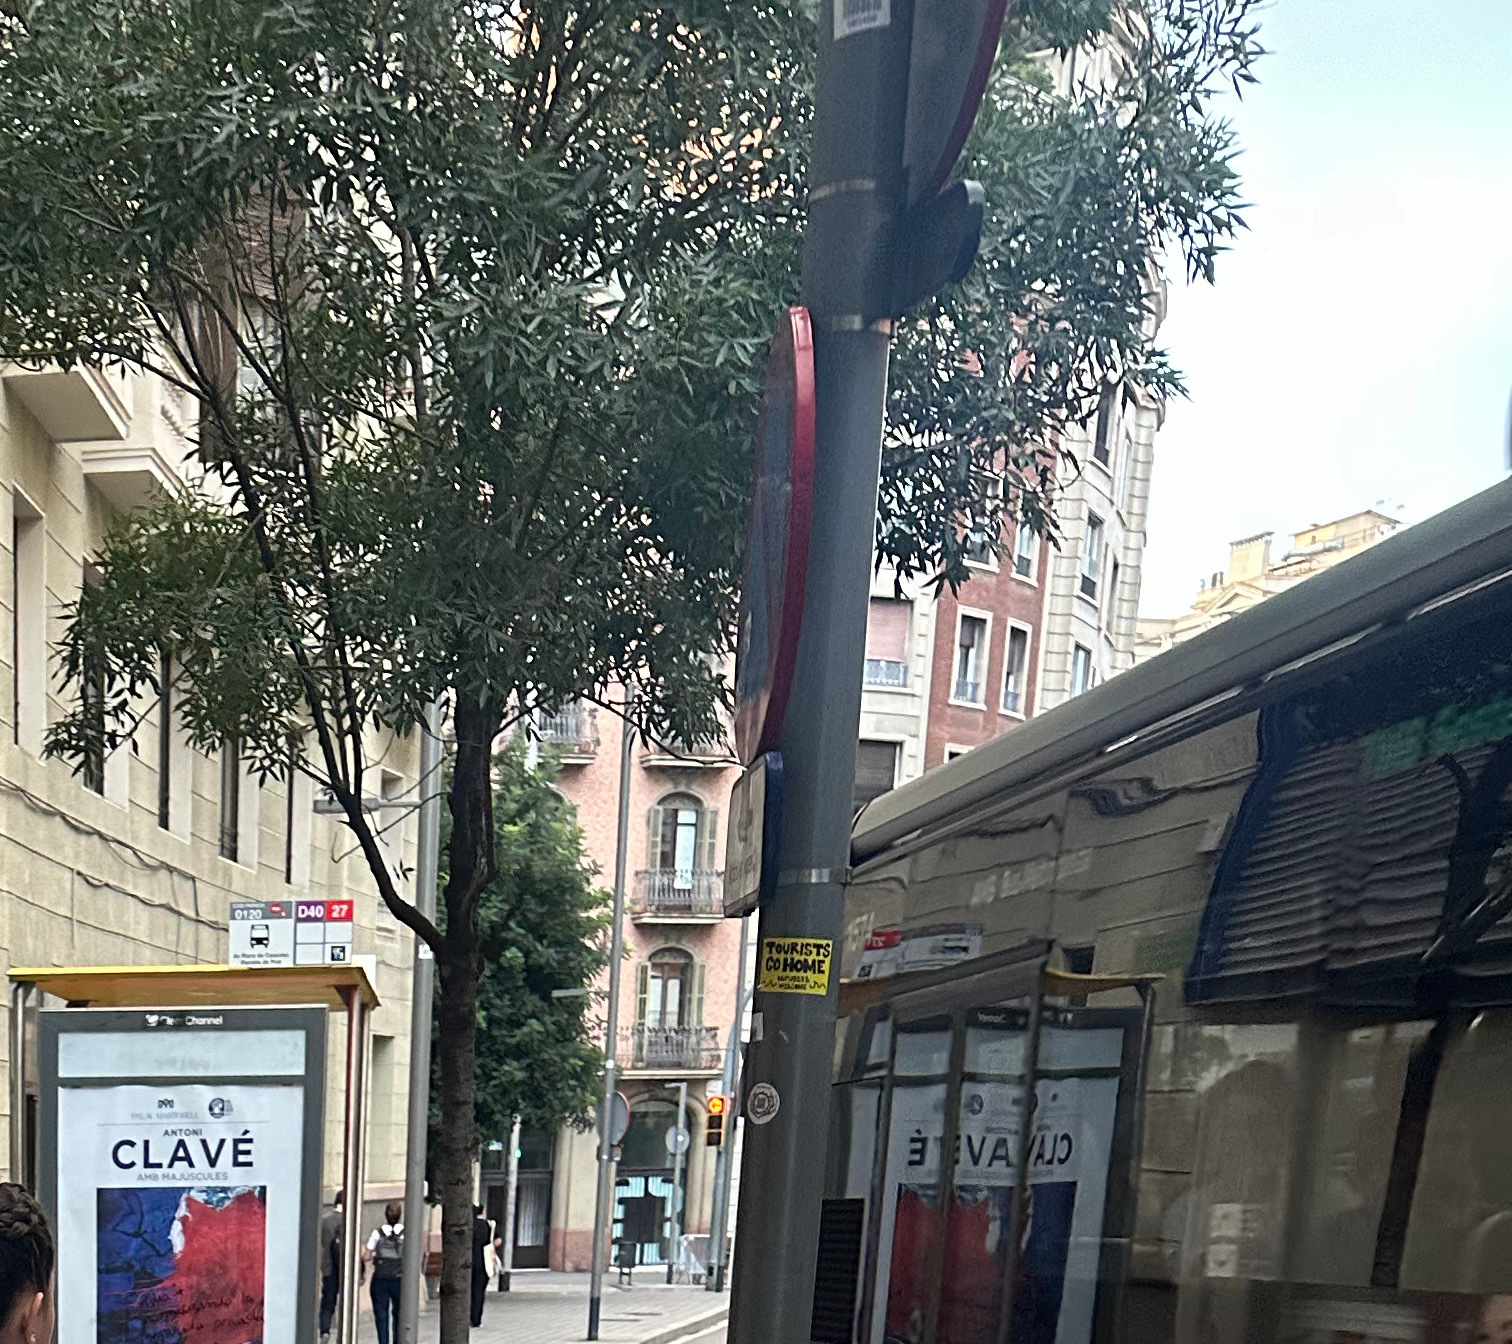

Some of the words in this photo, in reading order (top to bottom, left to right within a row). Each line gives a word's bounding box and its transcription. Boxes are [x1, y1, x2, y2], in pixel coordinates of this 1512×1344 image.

[234, 909, 263, 920] 0120
[298, 905, 324, 918] D40
[331, 904, 349, 918] 27
[766, 941, 831, 958] TOURISTS
[765, 956, 781, 972] GO
[782, 957, 826, 974] HOME
[185, 1015, 223, 1026] Channel
[163, 1127, 203, 1137] ANTONI
[112, 1129, 254, 1170] CLAVÉ
[136, 1173, 159, 1182] AMB
